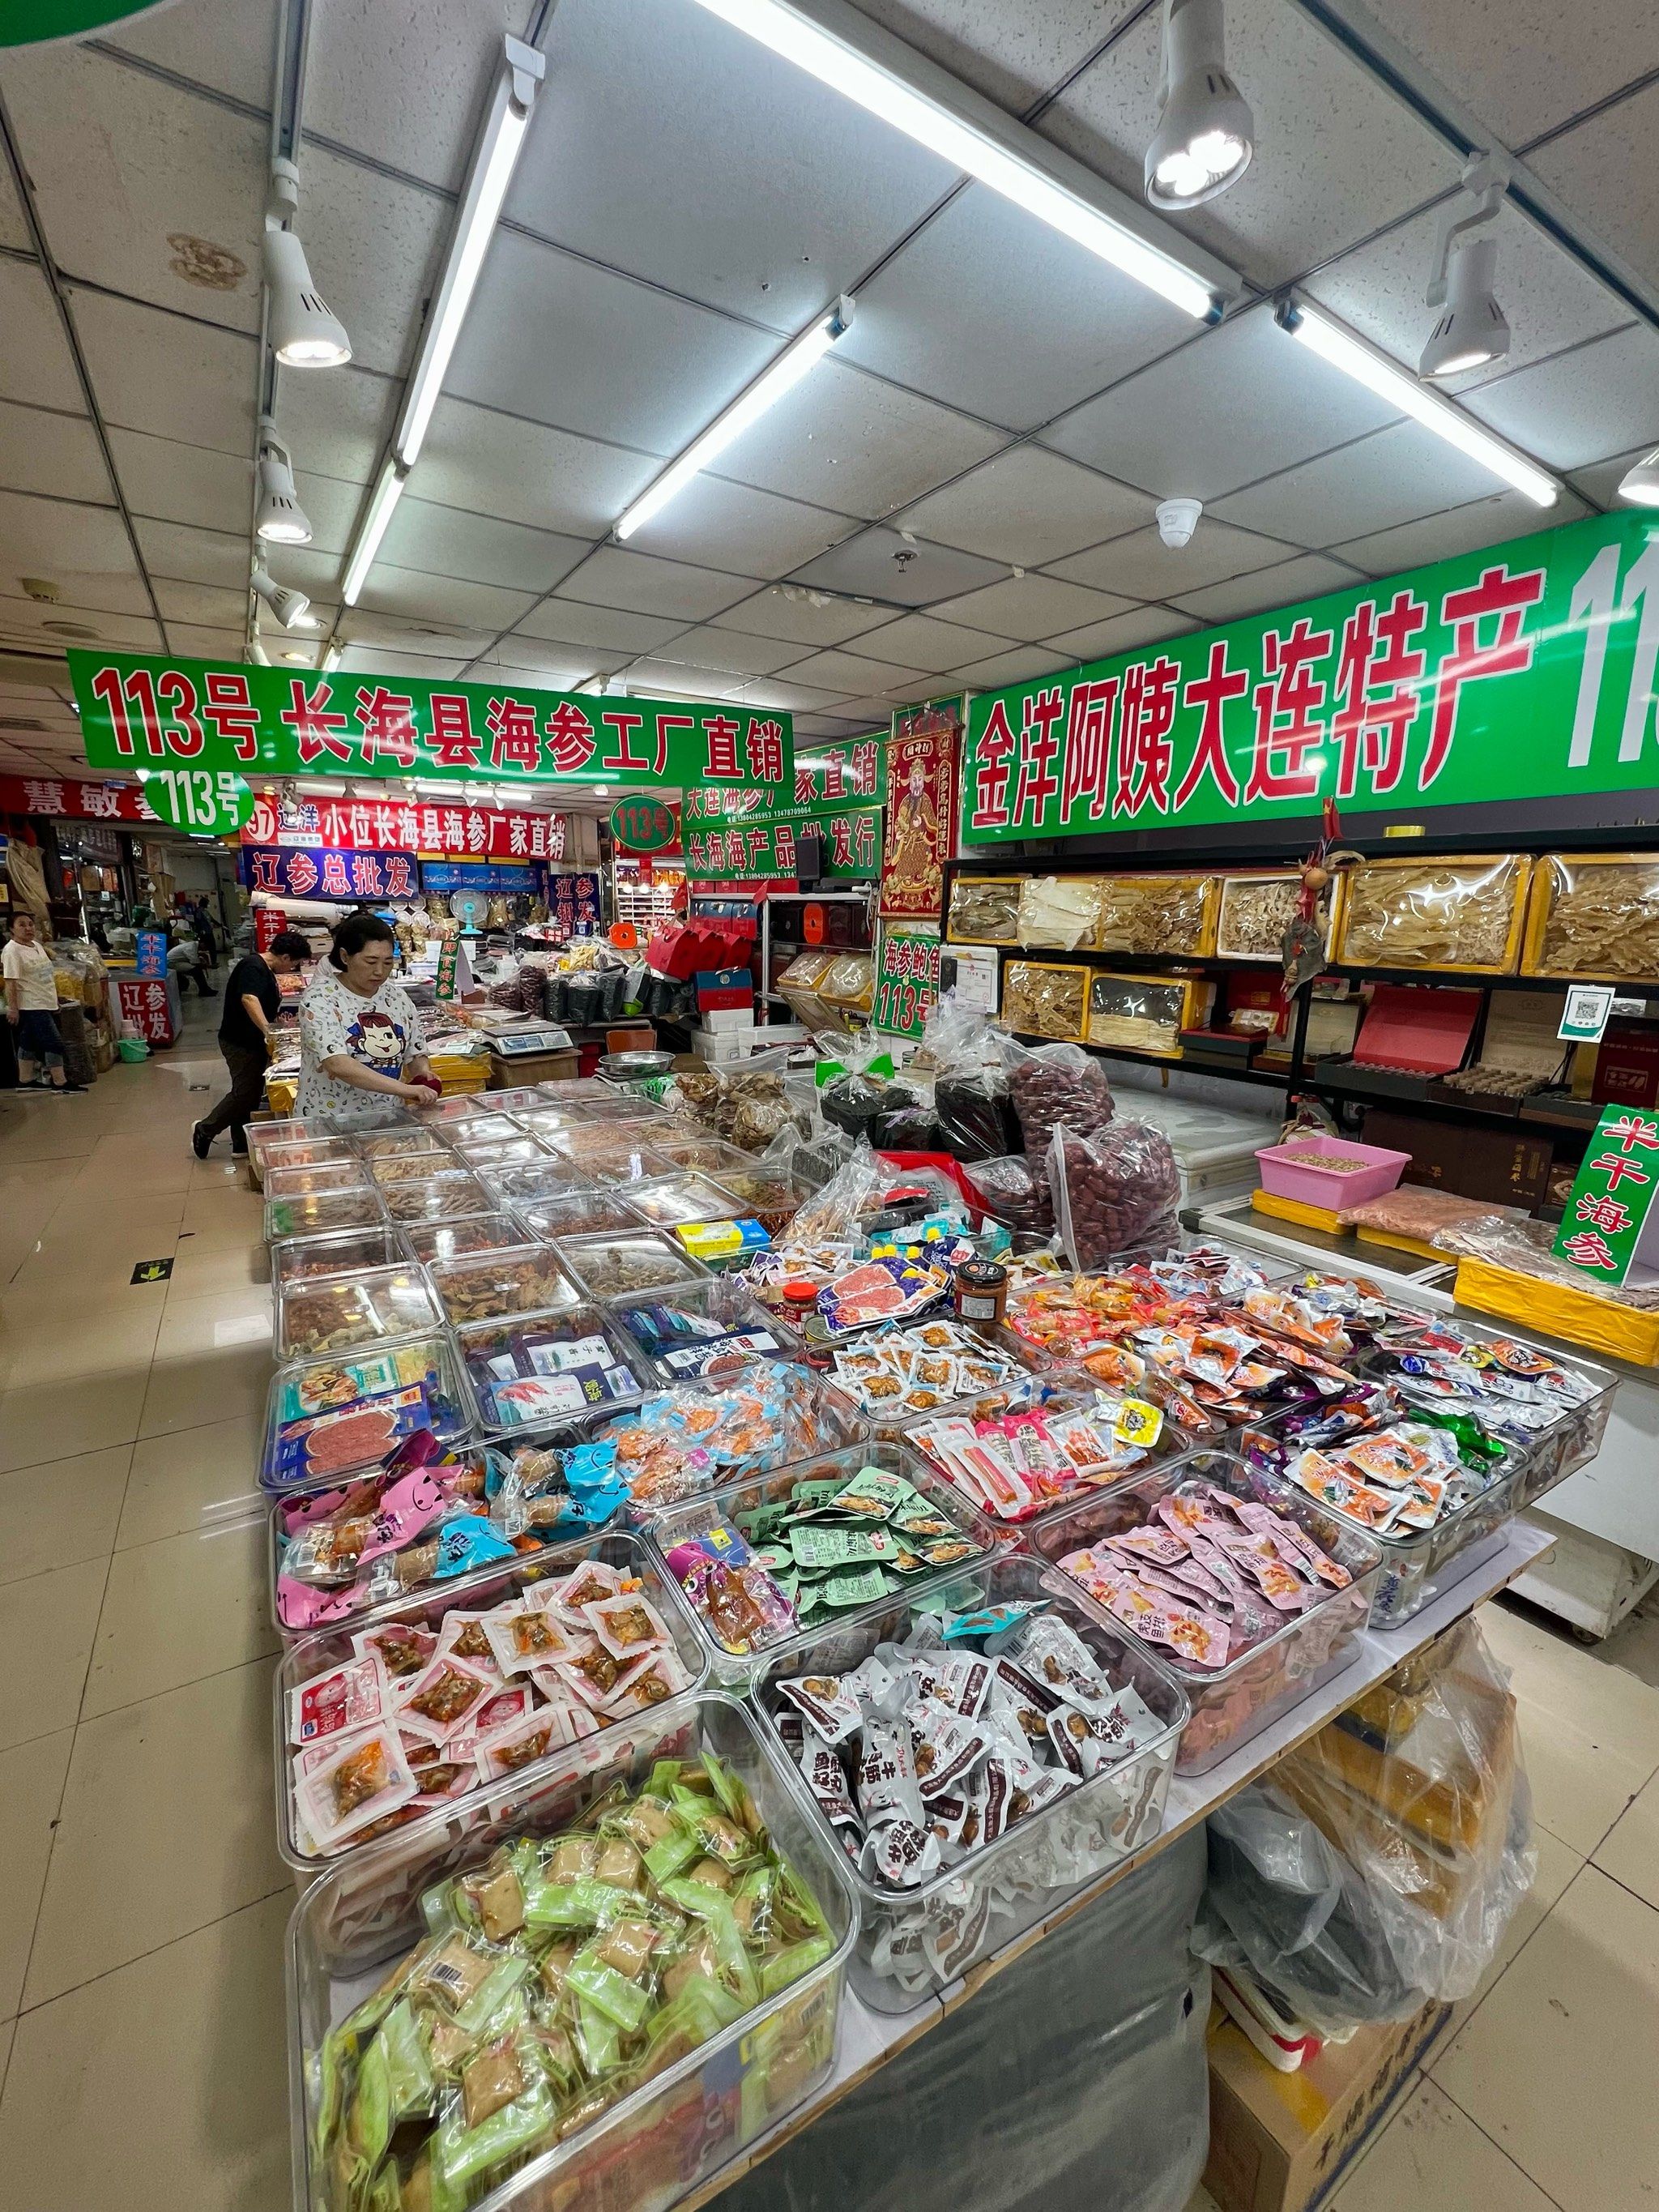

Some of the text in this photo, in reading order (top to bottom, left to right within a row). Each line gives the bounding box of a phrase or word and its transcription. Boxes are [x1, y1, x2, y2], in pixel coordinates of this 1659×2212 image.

[972, 540, 1659, 829] 金洋阿姨大连特产 11
[92, 667, 784, 783] 113号 长海县海参工厂直销
[160, 770, 240, 826] 113号
[616, 806, 669, 840] 113号
[325, 803, 565, 860] 小位长海县海参厂家直销
[252, 852, 413, 897] 辽参总批发
[262, 912, 280, 952] 半干海
[123, 983, 166, 1012] 辽参
[879, 981, 936, 1031] 113号
[1563, 1115, 1659, 1271] 半干海参
